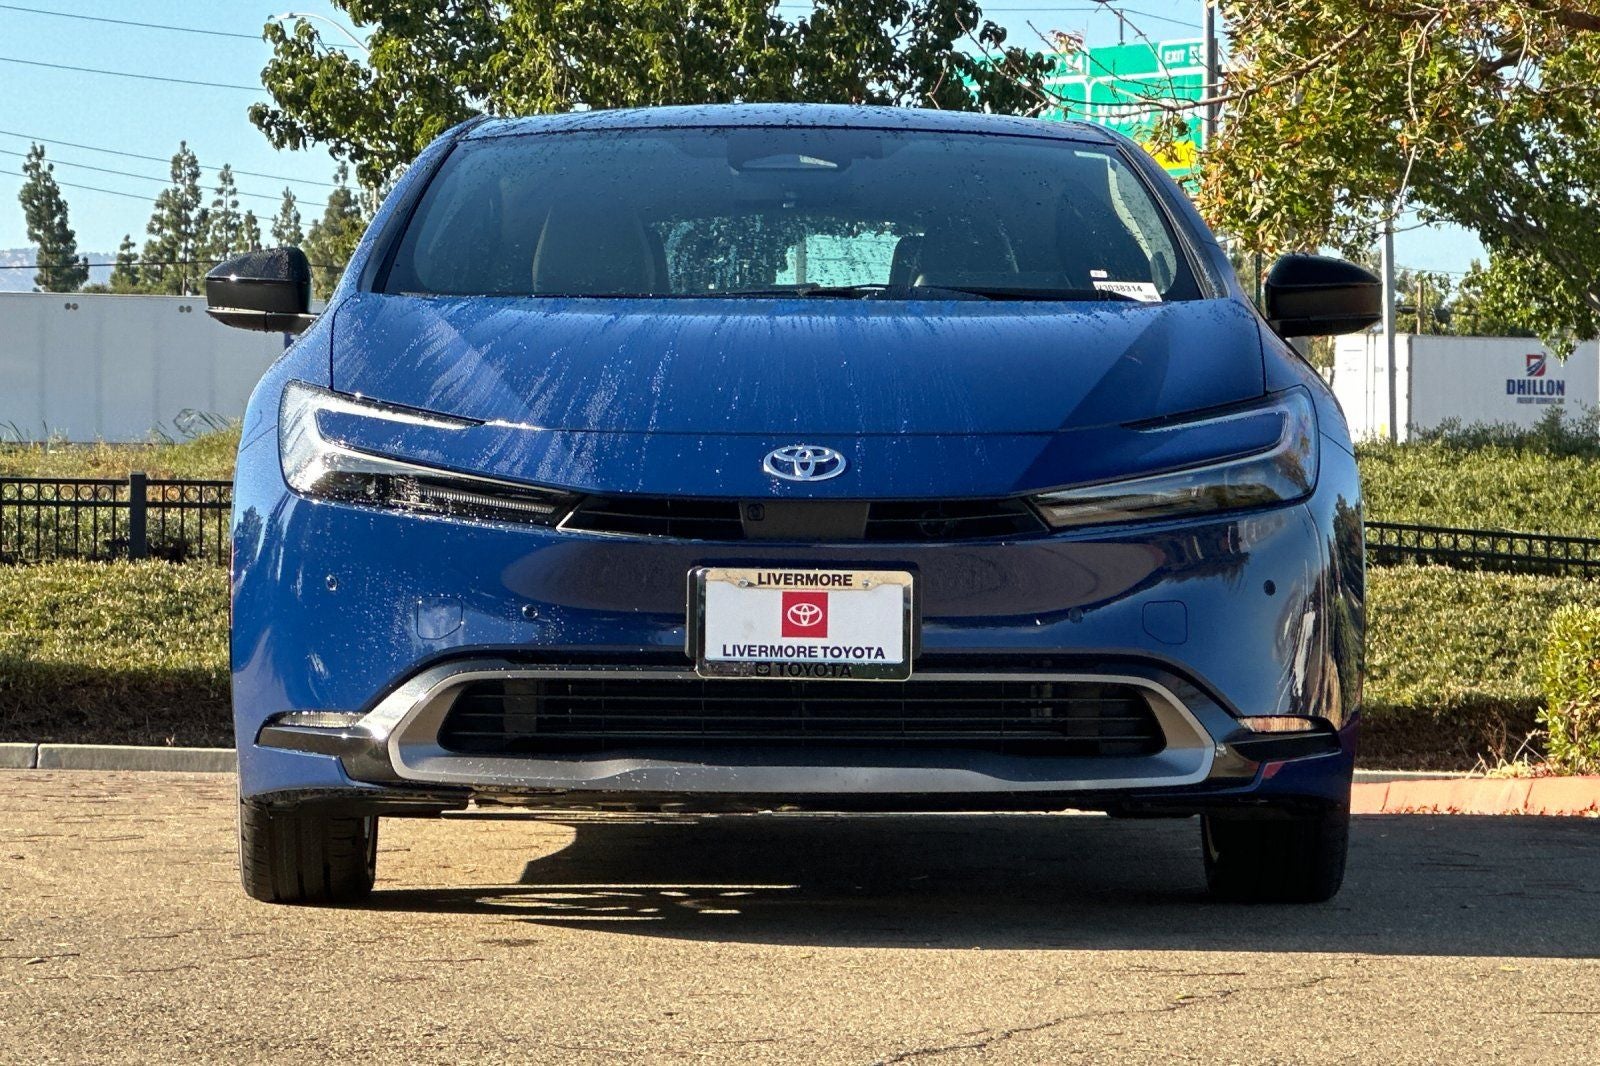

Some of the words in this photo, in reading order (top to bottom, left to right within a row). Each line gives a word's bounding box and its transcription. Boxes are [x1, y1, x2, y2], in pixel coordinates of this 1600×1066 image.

[1164, 49, 1186, 63] EXIT
[1506, 379, 1565, 396] DHILLON
[757, 572, 853, 587] LIVERMORE
[722, 644, 818, 658] LIVERMORE
[821, 646, 886, 660] TOYOTA
[775, 662, 852, 678] TOYOTA
